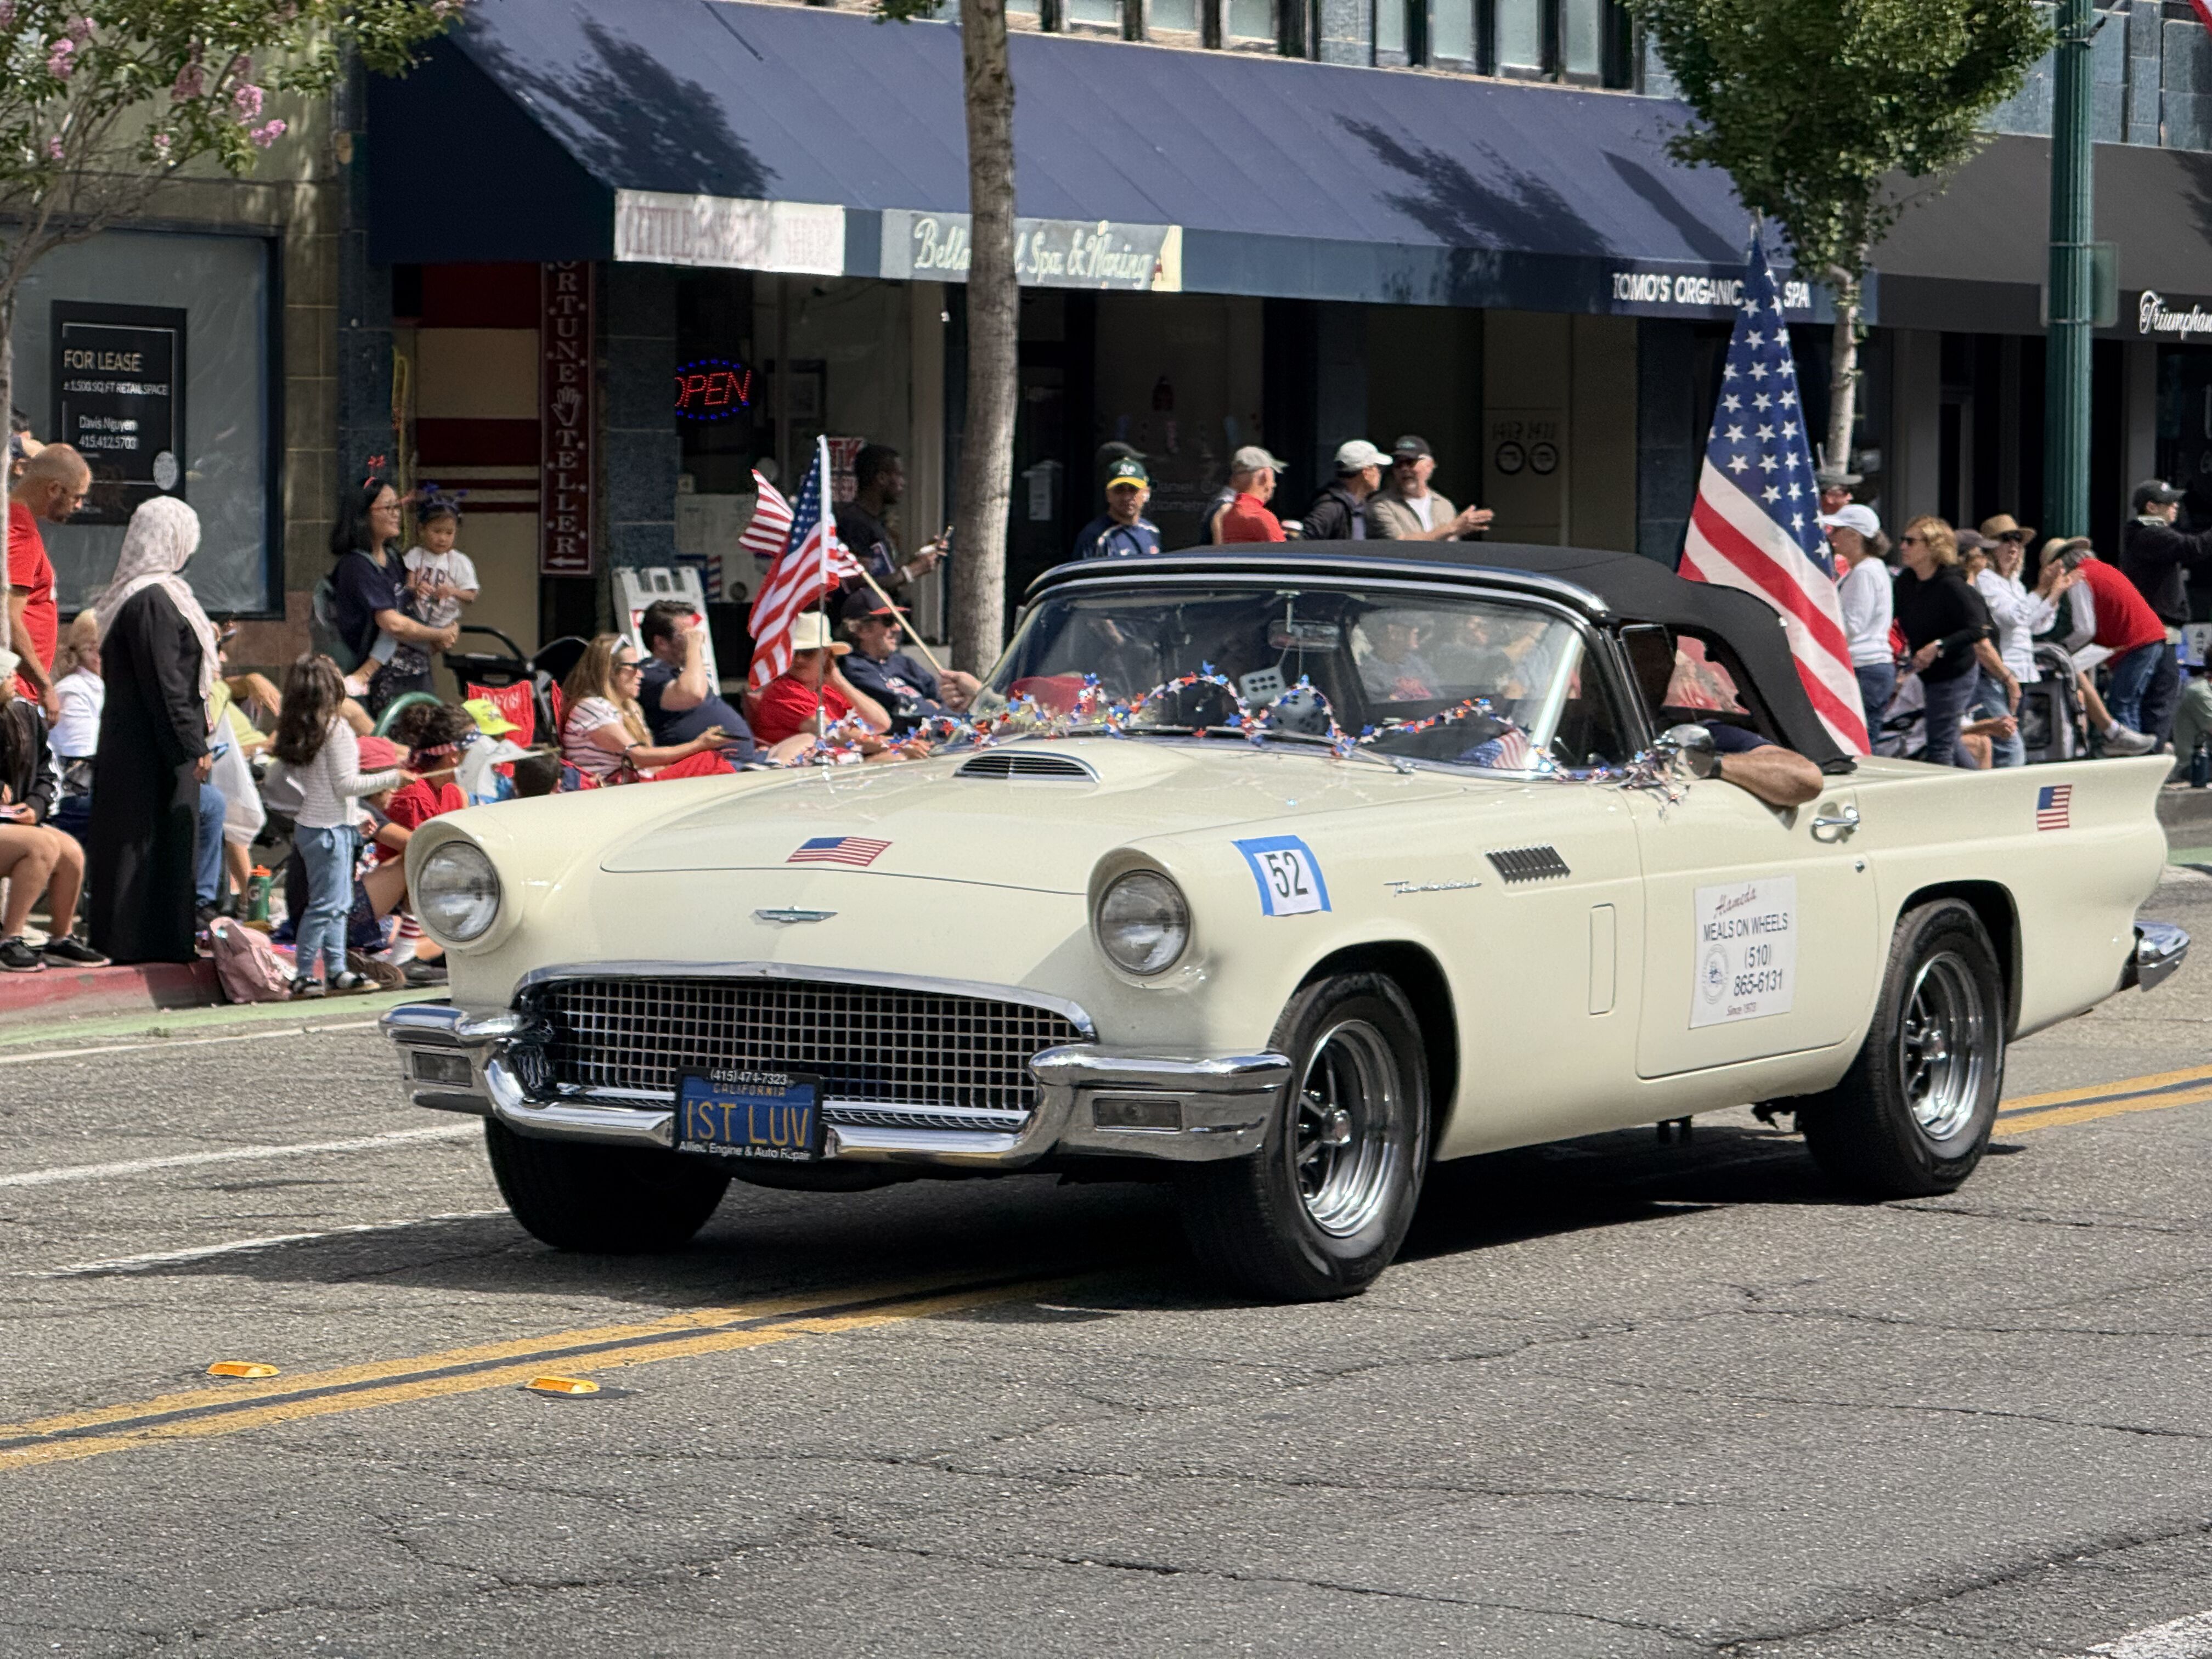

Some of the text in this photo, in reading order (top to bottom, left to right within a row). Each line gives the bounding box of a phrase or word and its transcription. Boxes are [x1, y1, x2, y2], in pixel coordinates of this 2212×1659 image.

[1027, 230, 1064, 283] Spa
[1067, 228, 1087, 275] &
[1613, 273, 1811, 308] TOMO'S ORGANIC SPA
[556, 260, 578, 383] RTUNE
[64, 349, 143, 373] FOR LEASE
[143, 383, 168, 396] SPACE
[79, 415, 137, 432] Davis Nguyen
[555, 430, 578, 554] TELLER
[1264, 851, 1308, 898] 52
[1703, 912, 1788, 942] MEALS ON WHEELS
[1745, 943, 1772, 969] (510)
[1734, 968, 1783, 996] 865-6131
[710, 1070, 787, 1085] (415) 474-7323
[713, 1082, 786, 1097] CALIFORNIA
[748, 1105, 809, 1147] LUV
[709, 1143, 743, 1158] Engine
[744, 1145, 753, 1156] &
[754, 1146, 778, 1159] Auto
